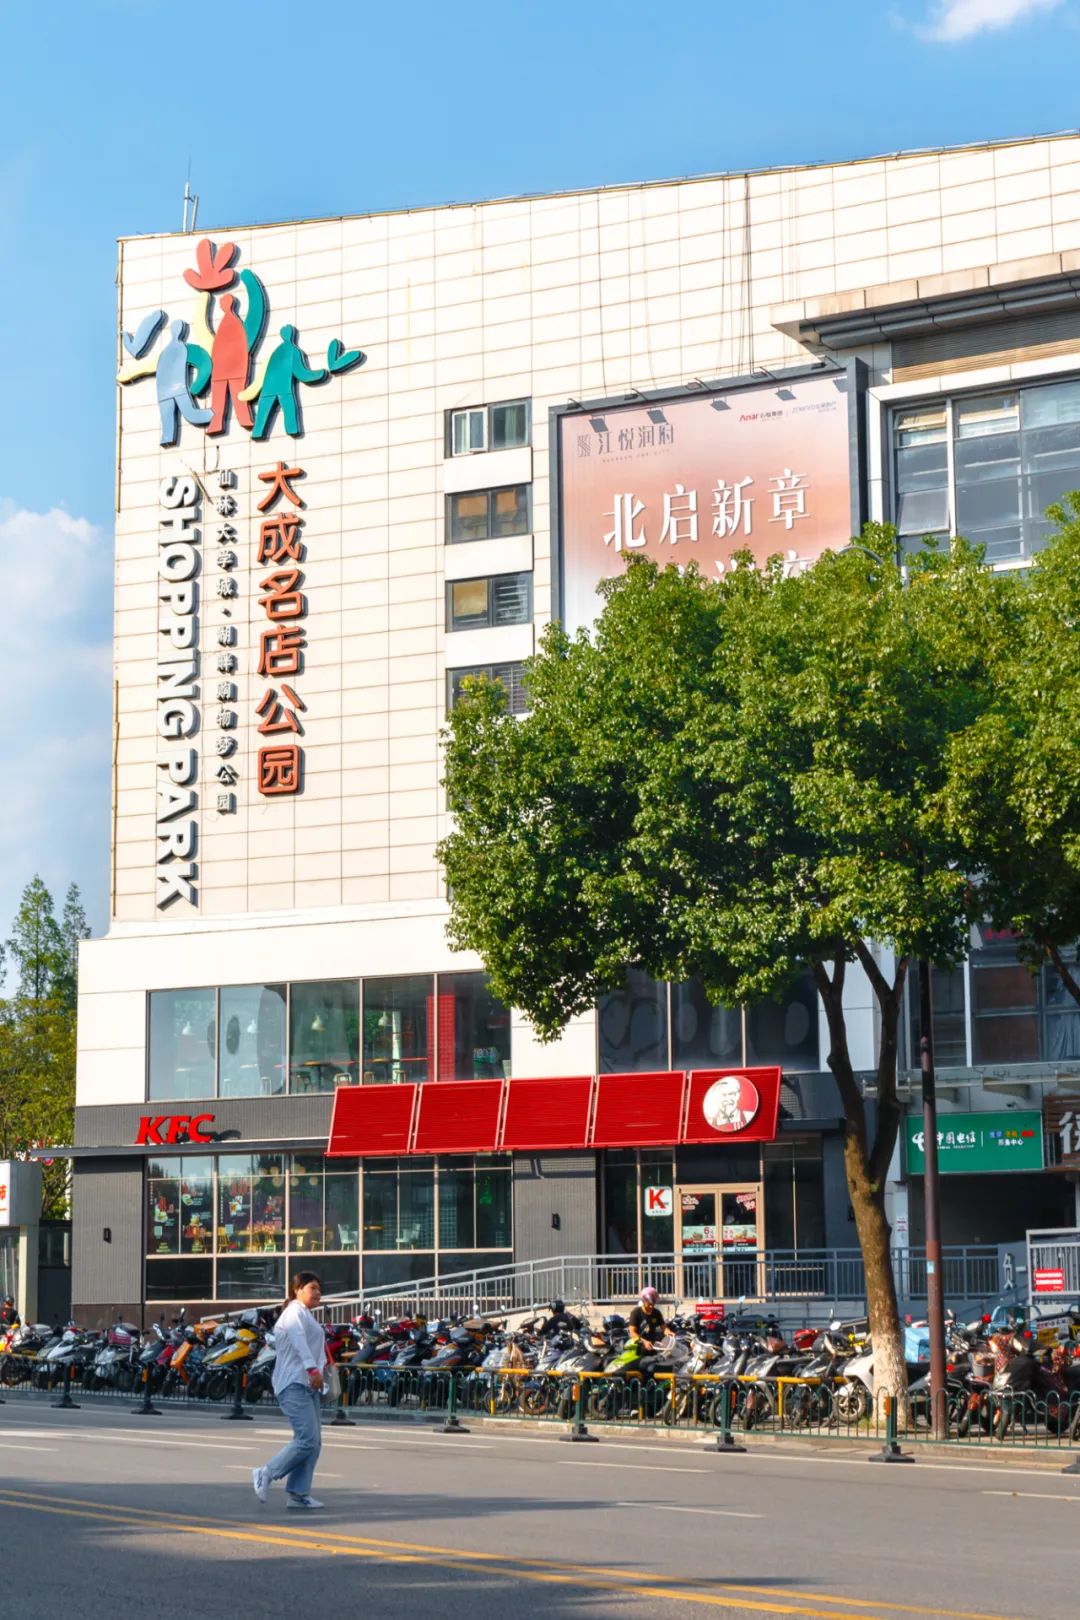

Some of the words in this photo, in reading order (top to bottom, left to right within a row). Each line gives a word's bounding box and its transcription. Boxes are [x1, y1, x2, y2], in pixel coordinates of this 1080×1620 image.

[602, 468, 811, 552] 北启新章
[158, 476, 202, 739] SHOPPING
[257, 461, 305, 794] 大成名店公园
[156, 748, 199, 911] PARK
[134, 1112, 215, 1145] KFC
